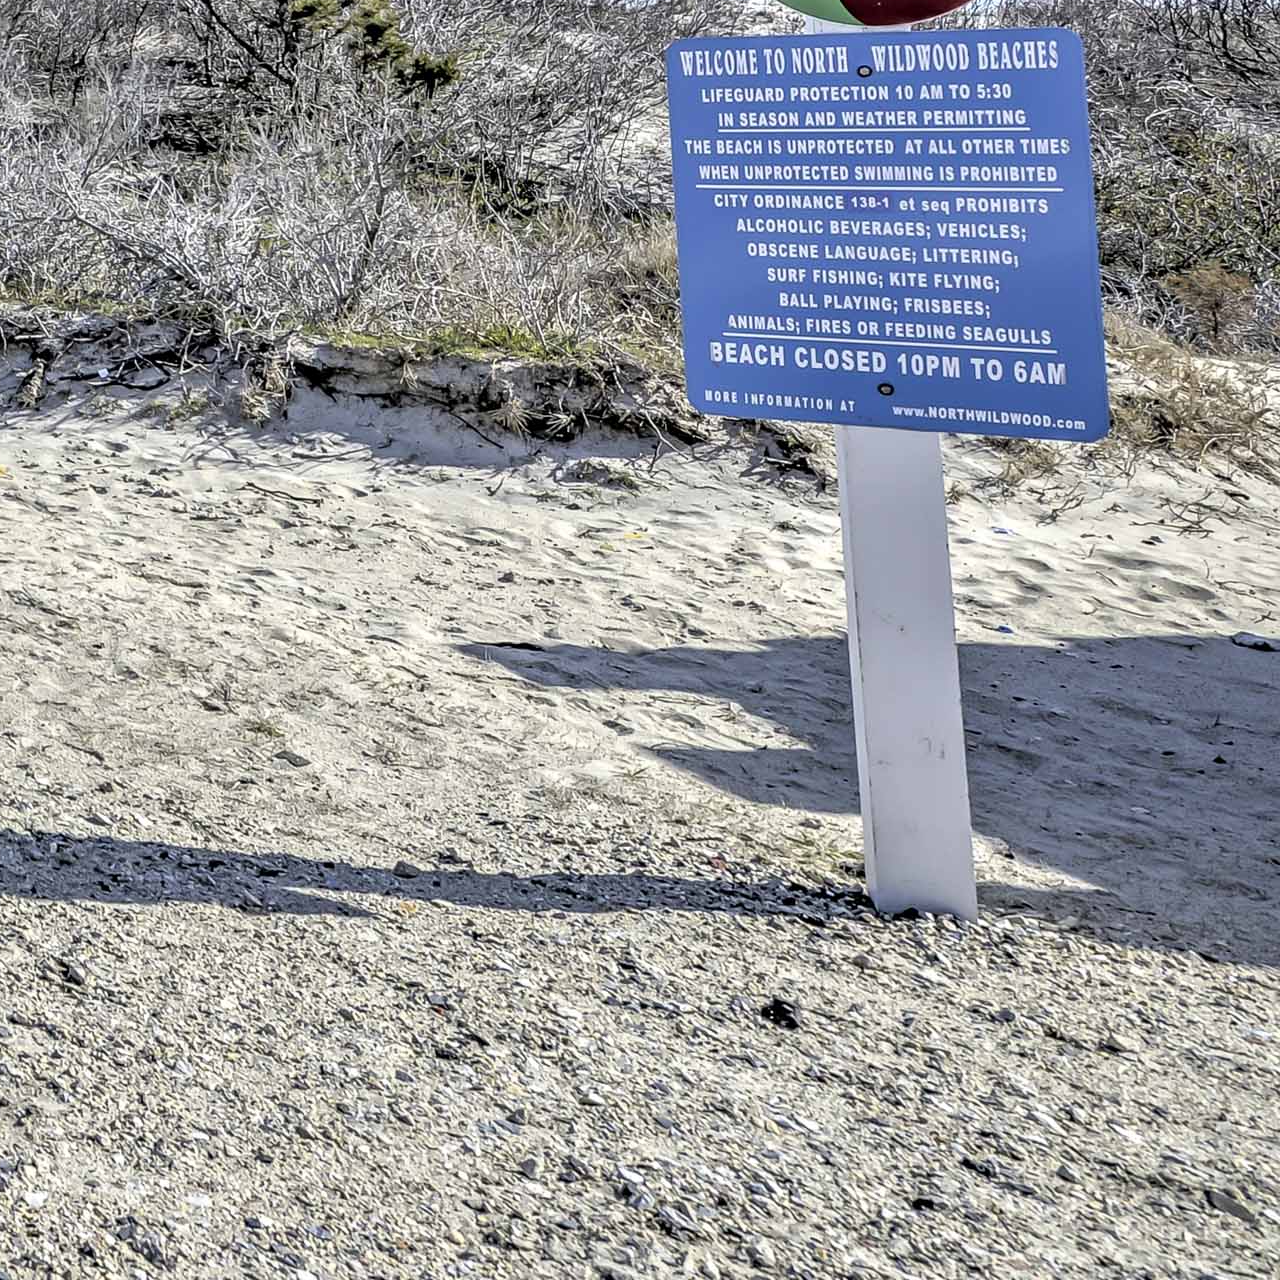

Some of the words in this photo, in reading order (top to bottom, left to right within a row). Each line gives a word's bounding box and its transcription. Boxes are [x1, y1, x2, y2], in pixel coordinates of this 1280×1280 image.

[680, 49, 758, 76] WELCOME
[764, 48, 785, 74] TO
[792, 46, 848, 73] NORTH
[872, 43, 969, 72] WILDWOOD
[977, 40, 1058, 70] BEACHES
[702, 87, 784, 102] LIFEGUARD
[791, 86, 888, 101] PROTECTION
[896, 86, 913, 100] 10
[920, 85, 943, 99] AM
[949, 85, 970, 98] TO
[977, 84, 1011, 98] 5:30
[719, 113, 733, 126] IN
[740, 112, 799, 126] SEASON
[805, 112, 835, 126] AND
[842, 111, 917, 125] WEATHER
[924, 110, 1026, 125] PERMITTING
[684, 140, 711, 154] THE
[717, 140, 762, 154] BEACH
[768, 140, 781, 154] IS
[788, 140, 894, 154] UNPROTECTED
[905, 140, 922, 154] AT
[929, 140, 956, 154] ALL
[962, 139, 1015, 154] OTHER
[1020, 139, 1070, 154] TIMES
[699, 165, 739, 180] WHEN
[745, 166, 848, 180] UNPROTECTED
[855, 166, 933, 181] SWIMMING
[940, 167, 954, 181] IS
[960, 166, 1057, 182] PROHIBITED
[714, 195, 748, 207] CITY
[754, 195, 844, 209] ORDINANCE
[851, 197, 889, 208] 138-1
[900, 198, 915, 211] et
[922, 199, 950, 215] seq
[956, 198, 1048, 214] PROHIBITS
[737, 219, 823, 233] ALCOHOLIC
[831, 220, 931, 239] BEVERAGES;
[937, 223, 1026, 241] VEHICLES;
[748, 243, 819, 258] OBSCENE
[825, 245, 916, 264] LANGUAGE;
[768, 268, 806, 282] SURF
[813, 270, 883, 288] FISHING;
[890, 273, 927, 287] KITE
[934, 274, 1000, 293] FLYING;
[780, 293, 818, 308] BALL
[824, 295, 898, 314] PLAYING;
[904, 298, 990, 318] FRISBEES;
[728, 315, 800, 334] ANIMALS;
[806, 319, 851, 334] FIRES
[857, 321, 879, 335] OR
[885, 323, 956, 339] FEEDING
[963, 326, 1052, 344] SEAGULLS
[710, 342, 784, 366] BEACH
[795, 347, 886, 372] CLOSED
[898, 353, 960, 378] 10PM
[971, 358, 1002, 381] TO
[1014, 361, 1066, 385] 6AM
[705, 390, 738, 403] MORE
[744, 393, 832, 411] INFORMATION
[840, 400, 855, 412] AT
[893, 406, 1086, 430] www.NORTHWILDWOOD.com
